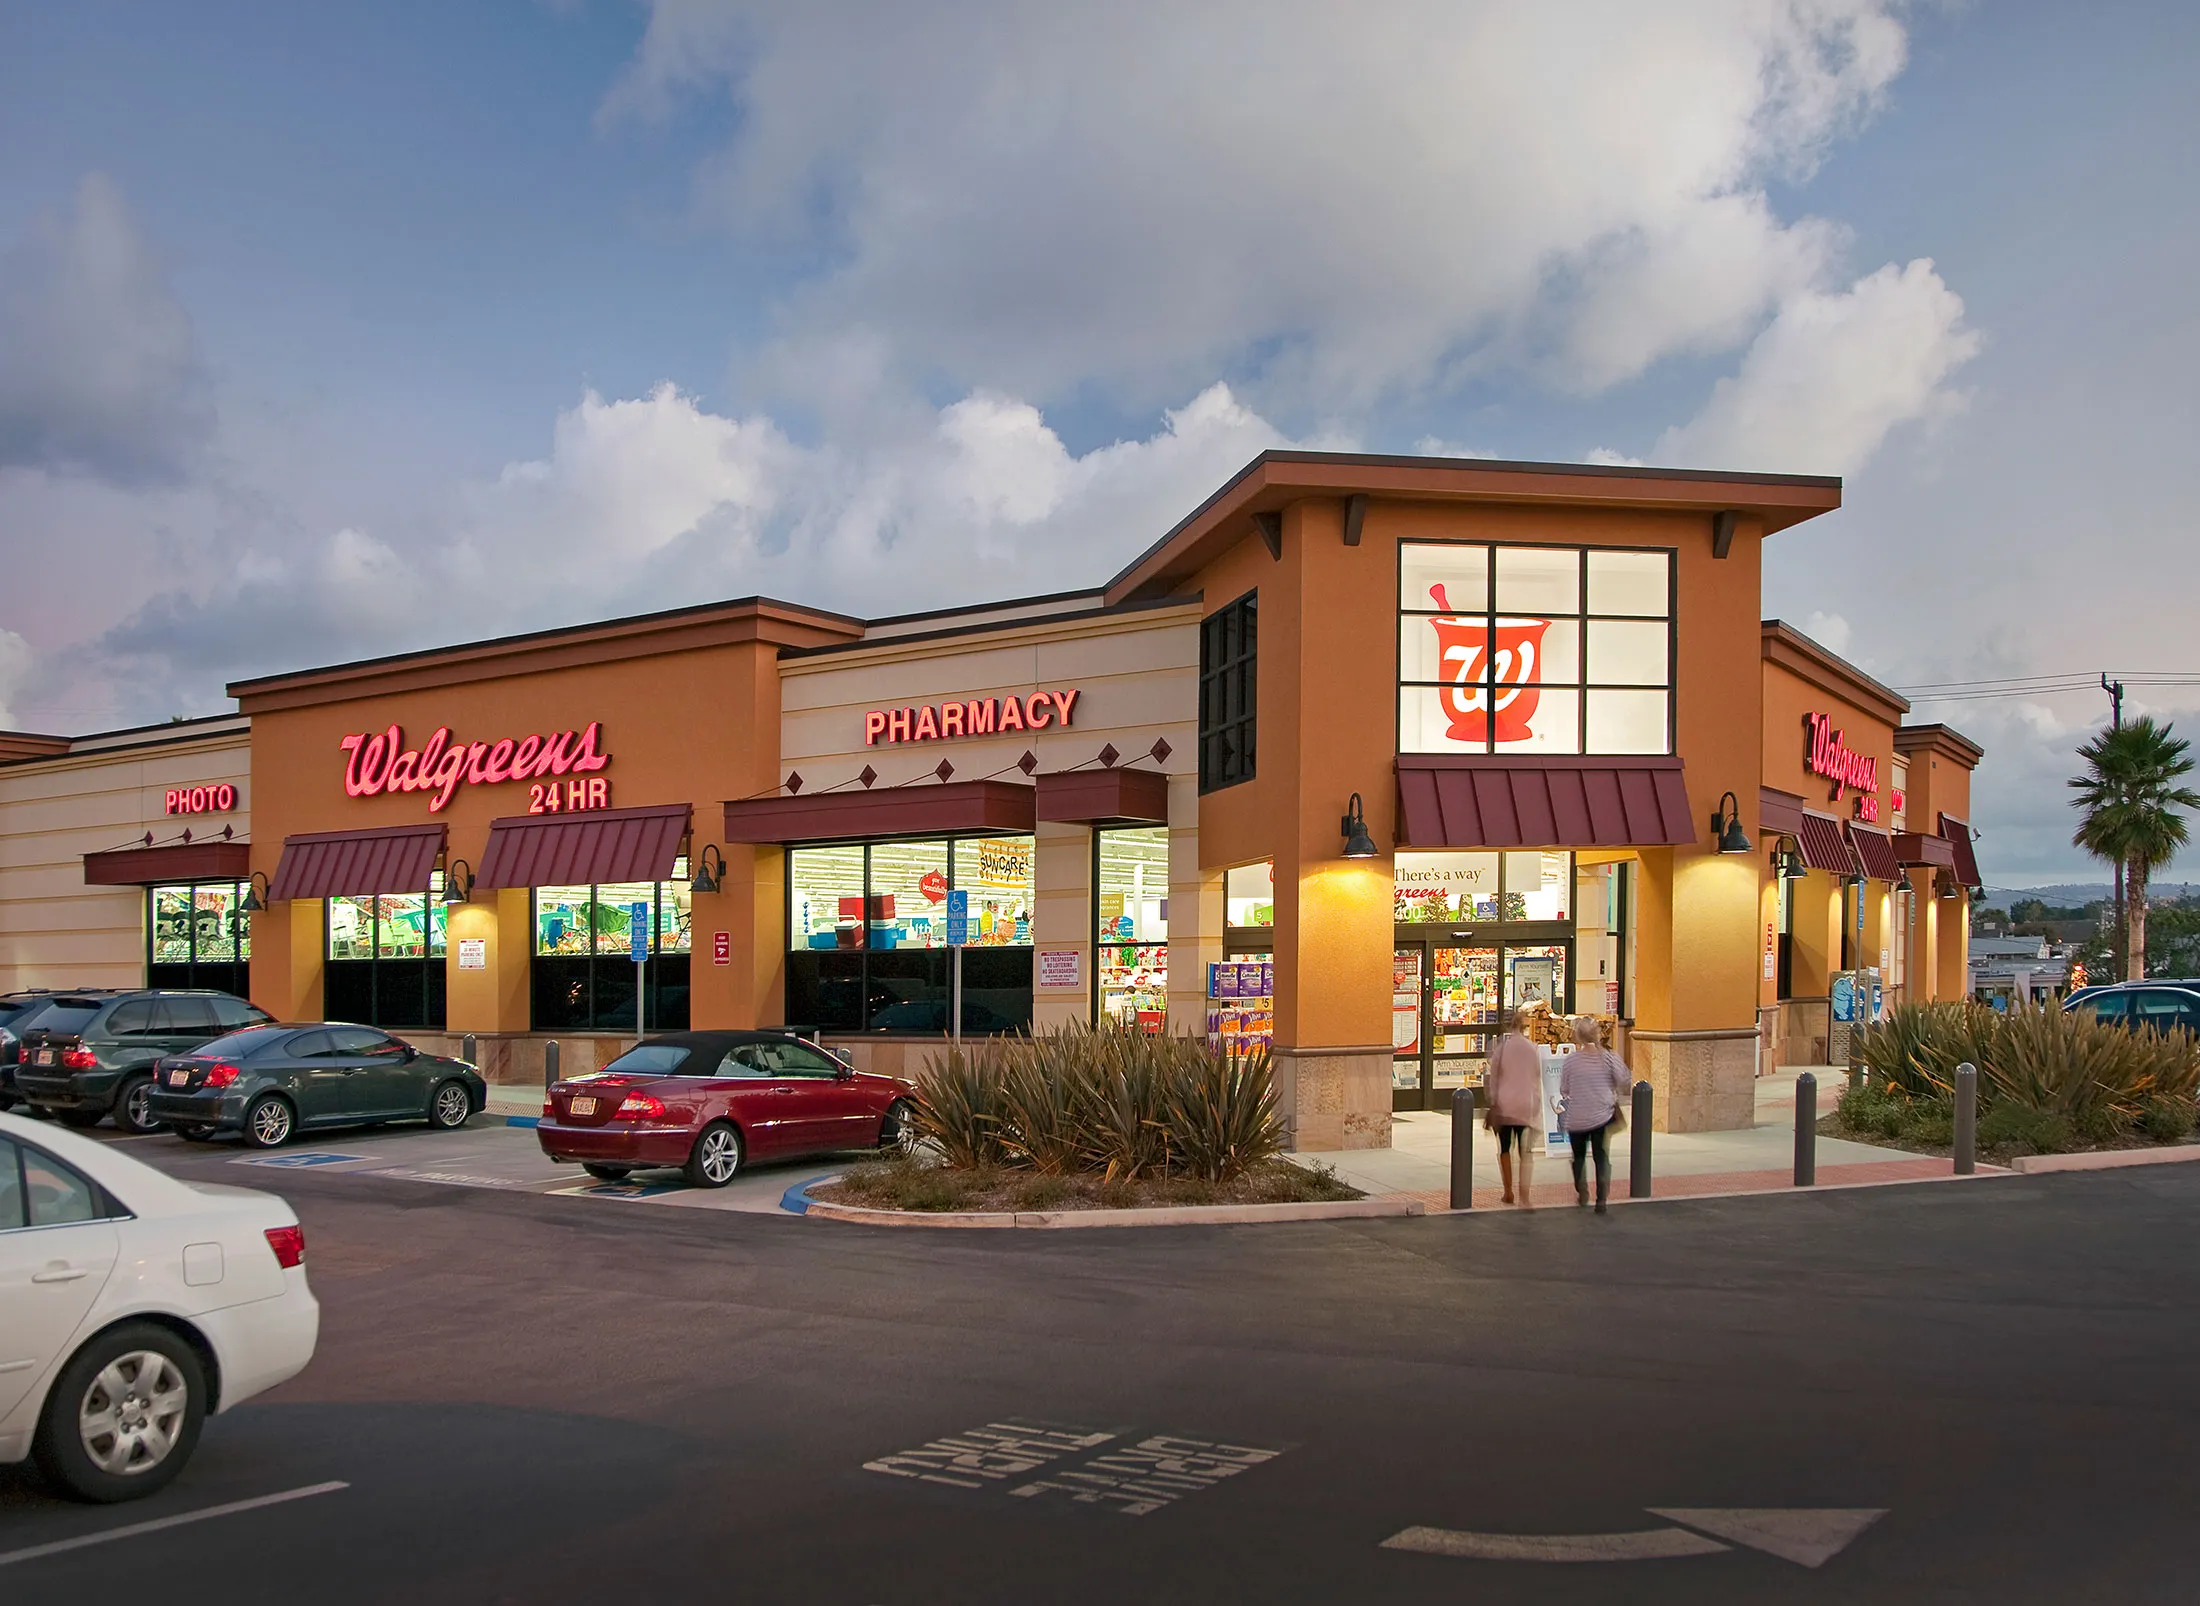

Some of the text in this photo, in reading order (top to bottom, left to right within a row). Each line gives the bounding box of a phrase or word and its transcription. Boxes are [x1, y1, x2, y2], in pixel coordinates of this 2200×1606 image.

[865, 689, 1081, 745] PHARMACY
[340, 721, 608, 813] Walgreens
[1810, 711, 1879, 801] Walgreens
[165, 783, 234, 815] PHOTO
[529, 778, 608, 814] 24 HR
[1860, 795, 1878, 822] 24 HR
[980, 855, 1026, 882] SUNCARE
[1394, 867, 1482, 883] There's a way
[1394, 886, 1448, 899] greens
[951, 921, 963, 929] ONLY
[861, 1422, 1117, 1489] THRU
[1006, 1435, 1282, 1516] DRIVE
